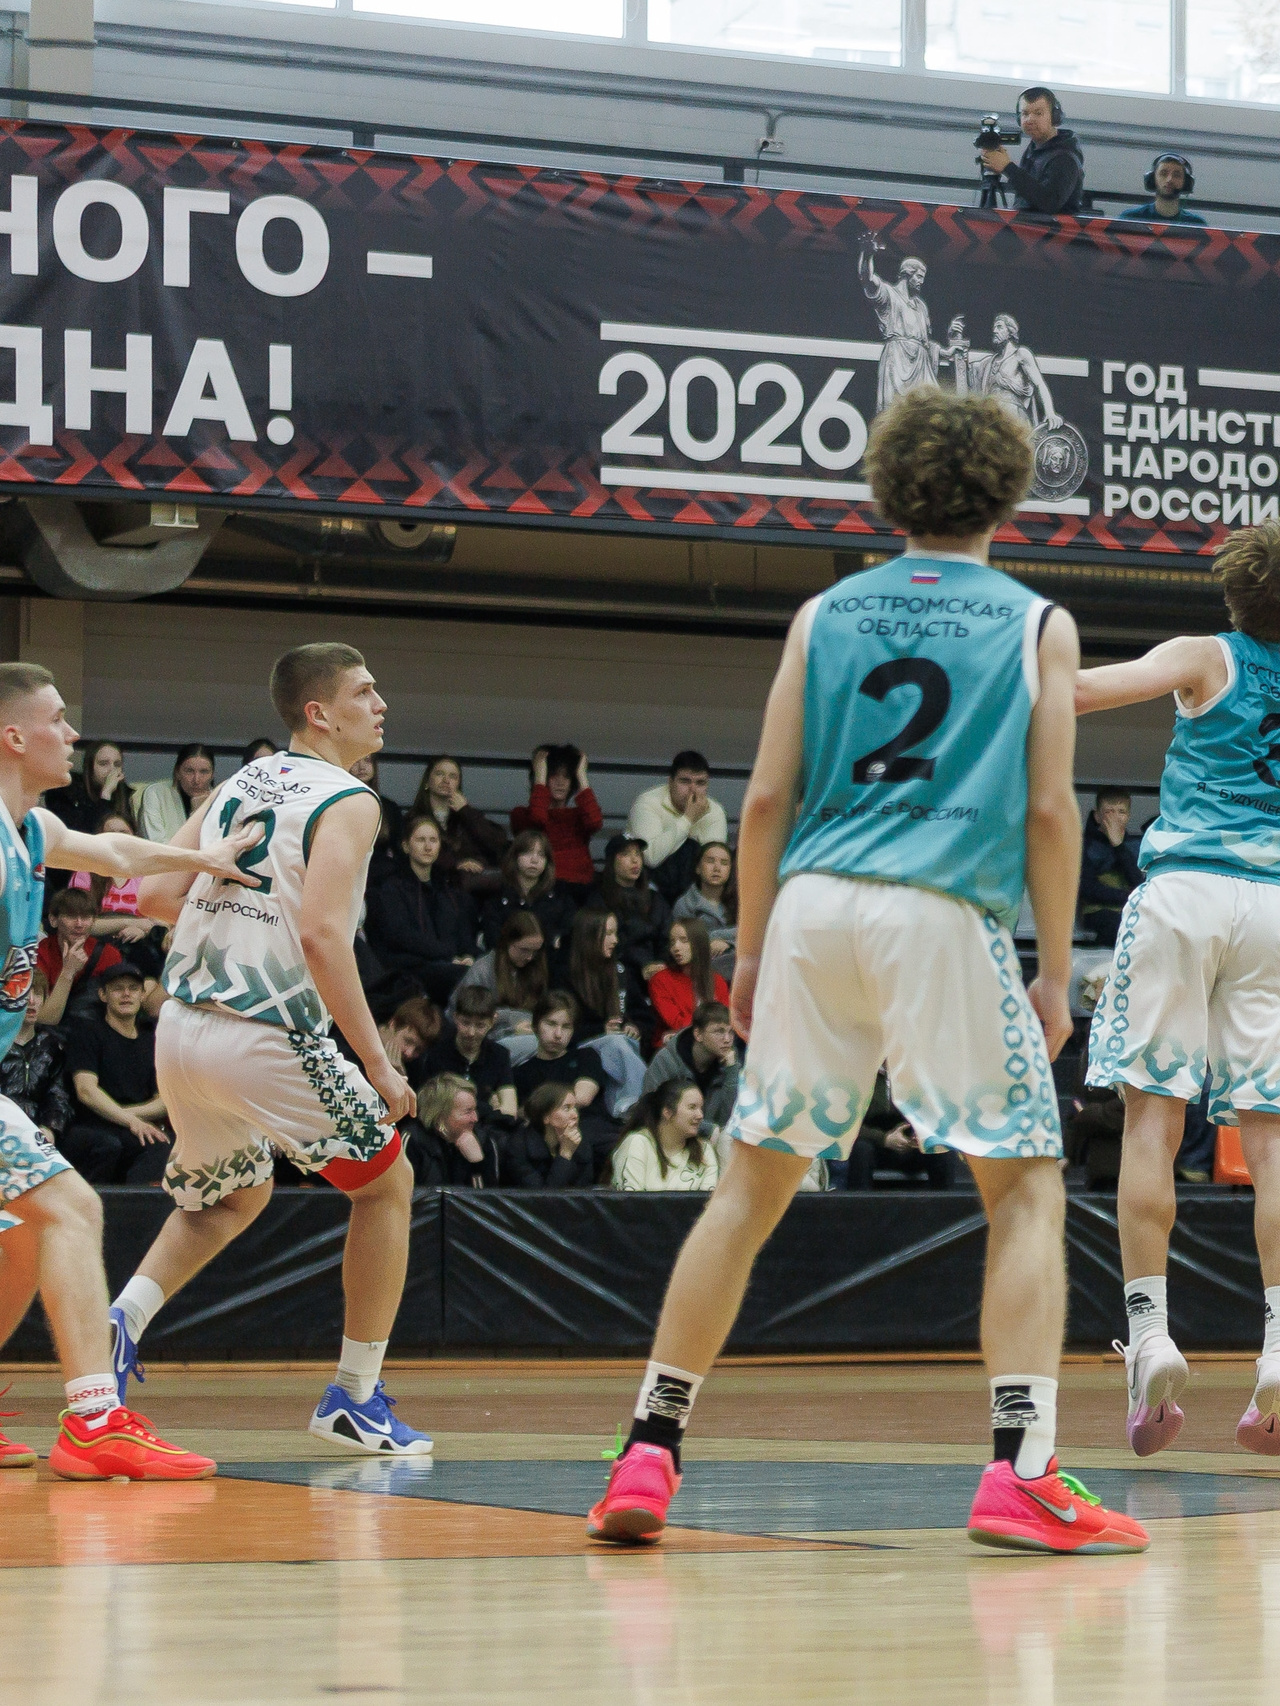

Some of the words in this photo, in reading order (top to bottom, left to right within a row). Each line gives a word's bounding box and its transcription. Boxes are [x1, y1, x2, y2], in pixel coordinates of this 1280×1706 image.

[1103, 360, 1188, 405] ГОД
[597, 350, 868, 471] 2026
[1103, 483, 1280, 527] РОССИИ
[827, 595, 1014, 620] КОСТРОМСКАЯ
[858, 617, 970, 639] ОБЛАСТЬ
[852, 657, 952, 785] 2
[1197, 781, 1207, 794] Я
[222, 900, 279, 927] РОССИИ!
